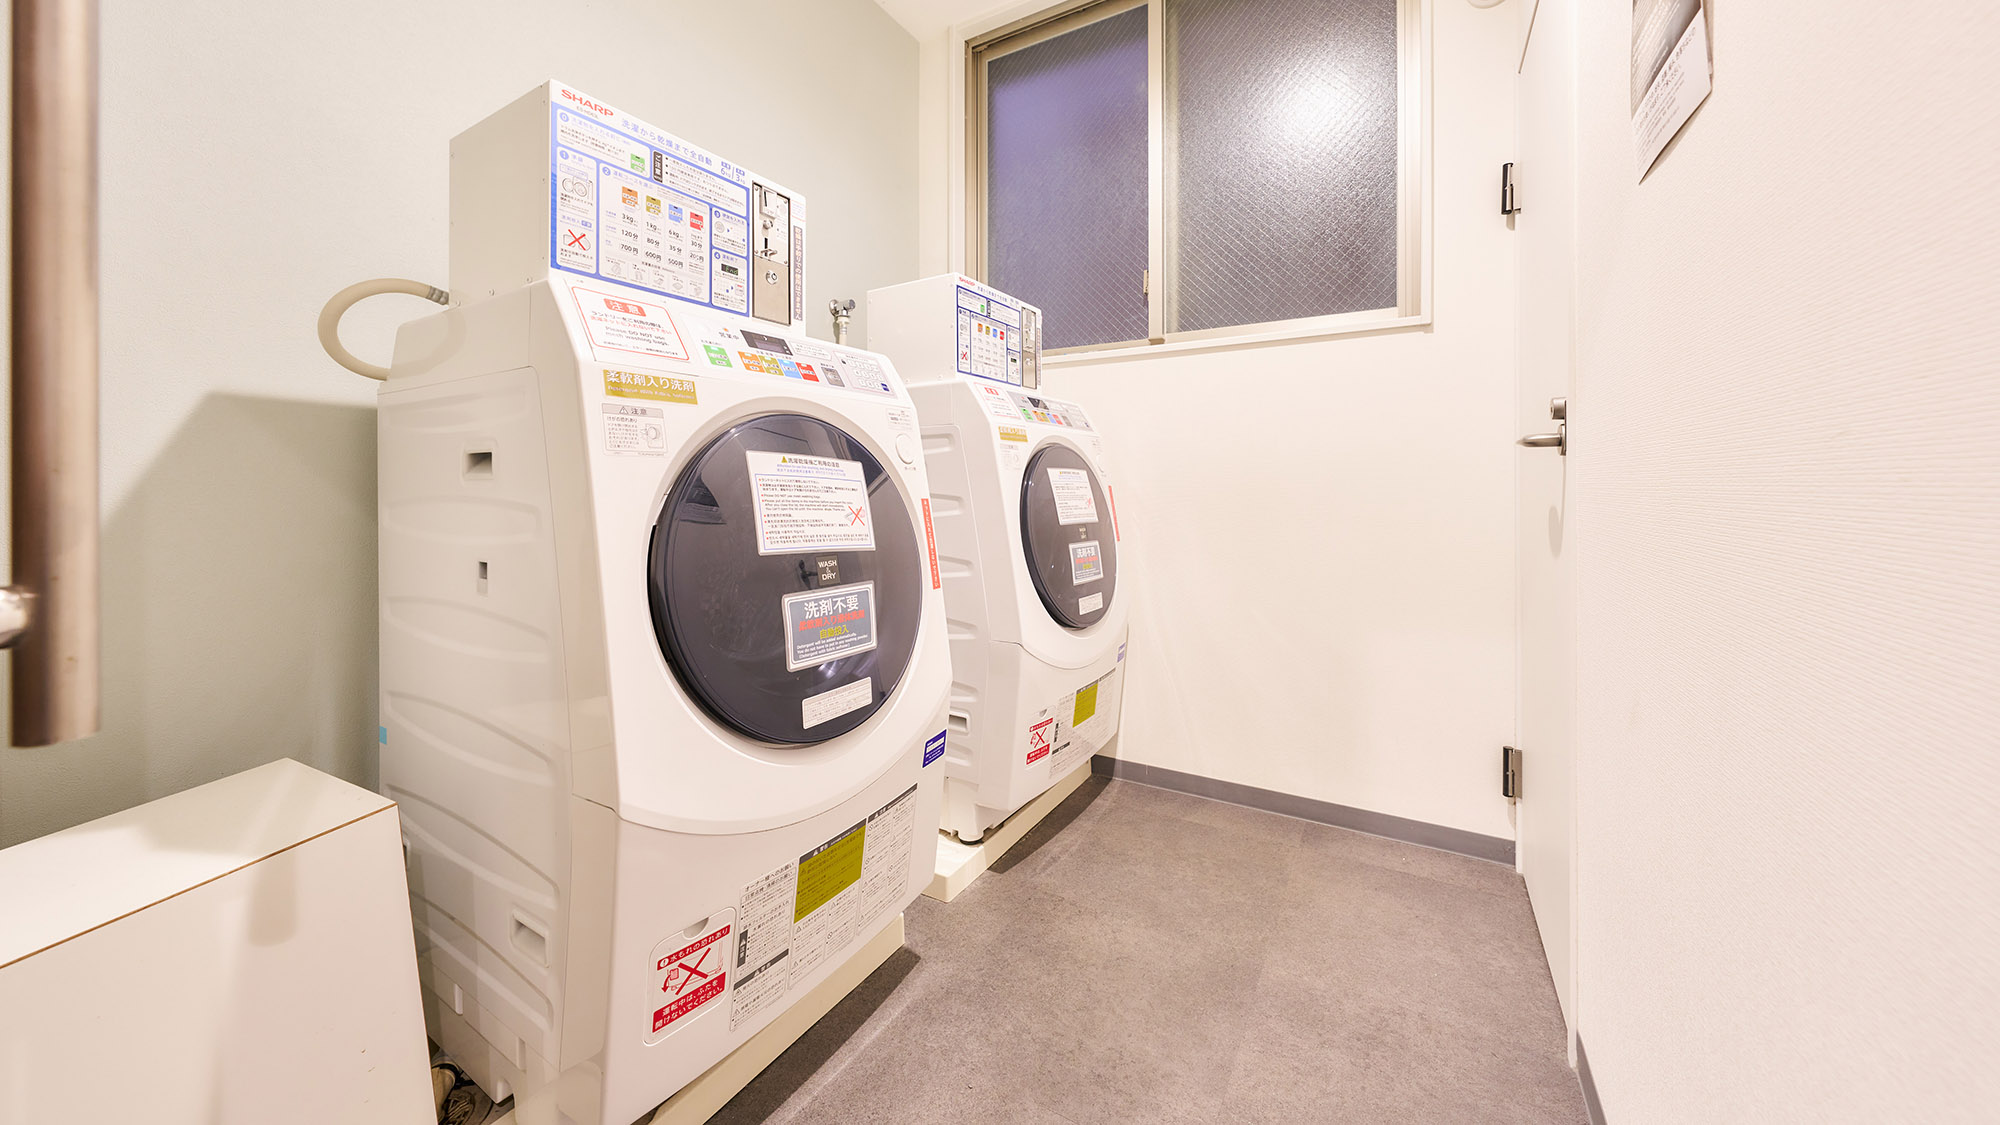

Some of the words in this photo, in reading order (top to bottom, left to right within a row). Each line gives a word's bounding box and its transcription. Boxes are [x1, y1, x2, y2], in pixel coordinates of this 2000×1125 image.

[561, 89, 614, 117] SHARP
[622, 118, 713, 167] 洗濯から乾燥まで全自動
[621, 229, 639, 240] 120分
[646, 237, 661, 247] 80分
[620, 243, 639, 256] 700円
[644, 250, 662, 262] 600円
[669, 245, 682, 254] 35分
[609, 299, 641, 315] 注意
[605, 326, 627, 334] Please
[625, 334, 653, 344] washing
[607, 371, 694, 392] 柔軟剤入り洗剤
[631, 407, 648, 415] 注意
[818, 560, 837, 568] WASH
[821, 572, 836, 581] DRY
[804, 595, 859, 619] 洗剤不要
[819, 624, 849, 639] 自動投入
[796, 642, 814, 650] Detergent
[745, 862, 794, 892] オーナー様へのお願い
[670, 928, 729, 963] 水もれの恐れあり
[662, 980, 719, 1016] 運転中は、ふたを
[655, 987, 723, 1030] 開けないでください。
